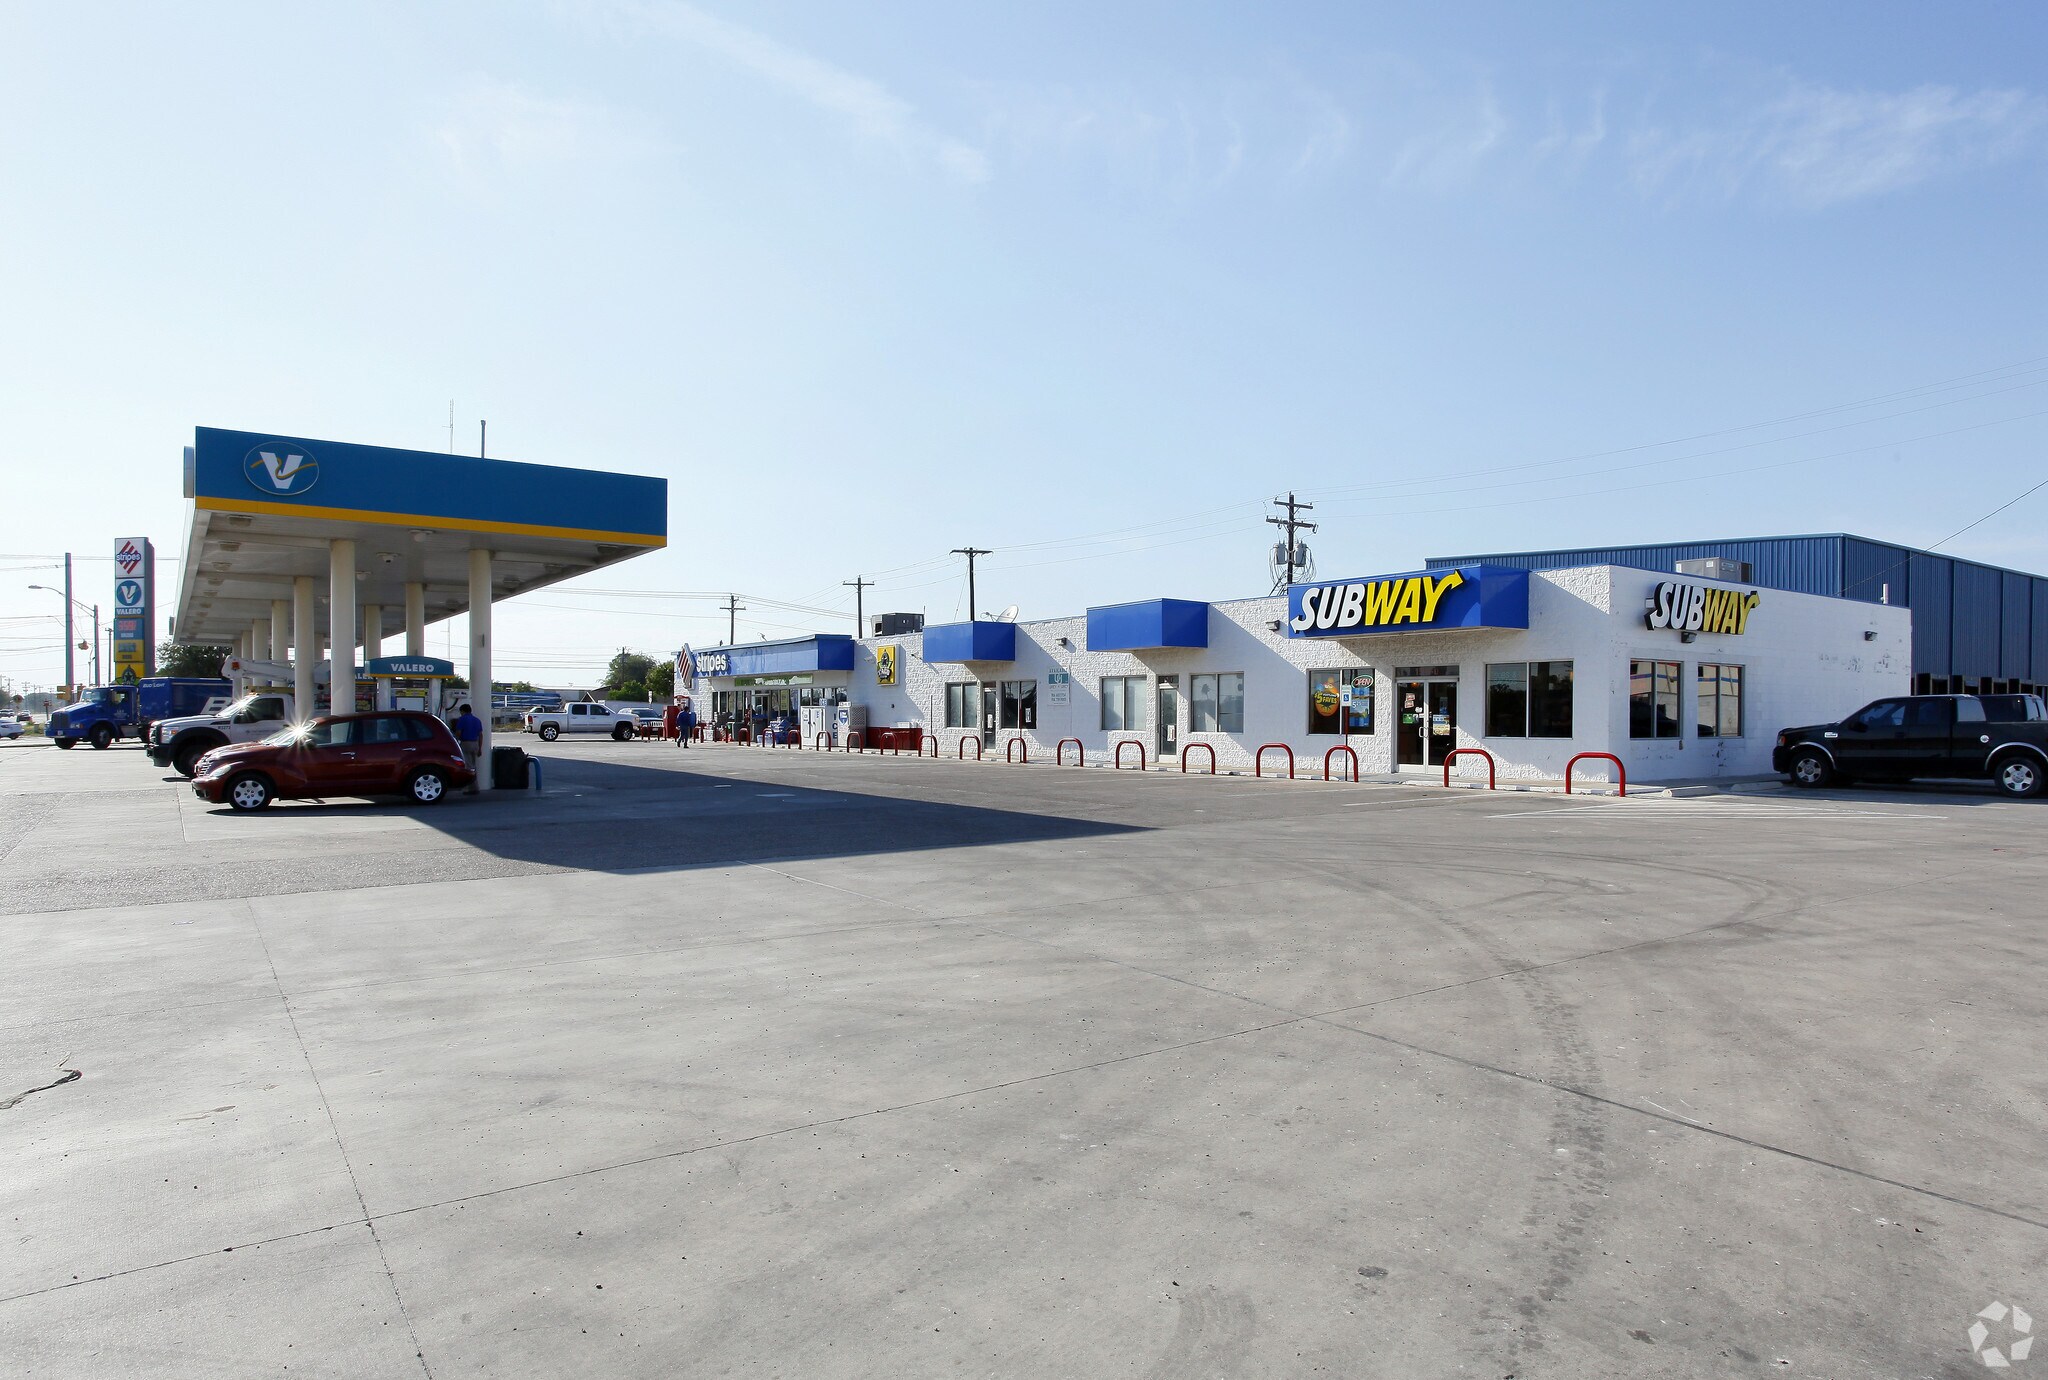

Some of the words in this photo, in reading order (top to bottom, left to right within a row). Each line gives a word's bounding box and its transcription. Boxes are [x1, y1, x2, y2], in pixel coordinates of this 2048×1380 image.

[116, 553, 141, 563] stripes
[1290, 569, 1464, 634] SUBWAY
[1649, 581, 1760, 635] SUBWAY
[391, 663, 435, 673] VALERO
[696, 653, 727, 677] stripes
[1354, 678, 1371, 687] OPEN
